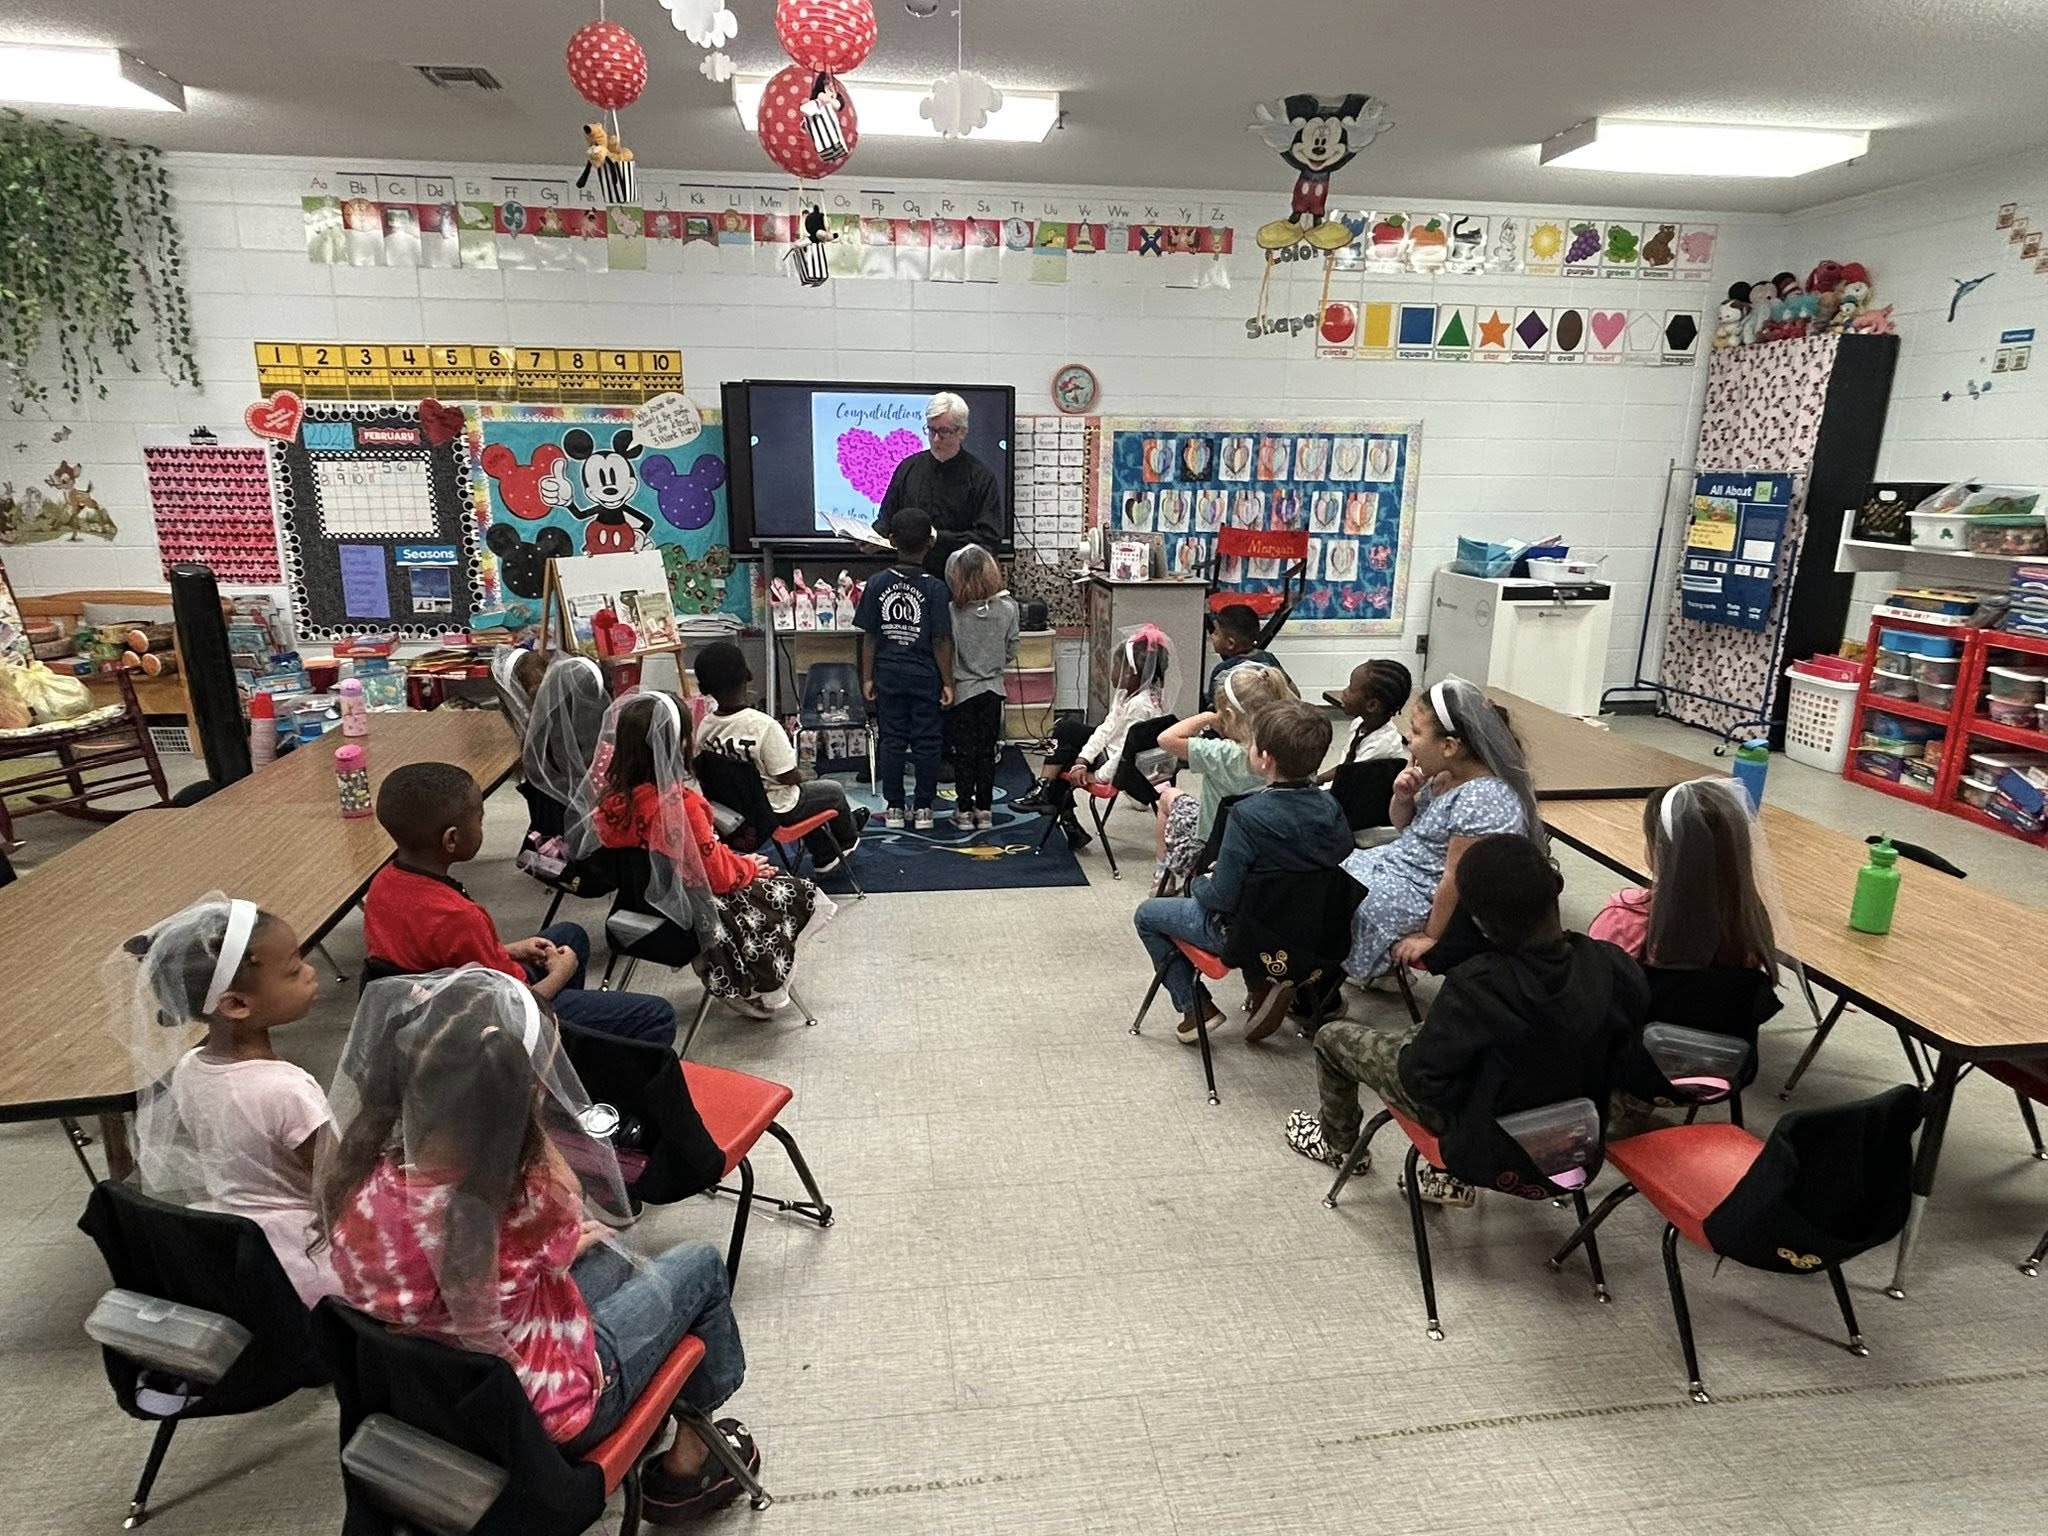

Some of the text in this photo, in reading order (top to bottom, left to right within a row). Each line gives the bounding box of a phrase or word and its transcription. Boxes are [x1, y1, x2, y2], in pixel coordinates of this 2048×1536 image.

[349, 181, 368, 194] Bb
[388, 182, 406, 195] Cc
[426, 183, 444, 197] Dd
[504, 186, 519, 199] Ff
[540, 187, 559, 205] Gg
[579, 189, 595, 202] Hh
[655, 190, 668, 209] Jj
[690, 193, 706, 205] Kk
[729, 194, 741, 207] Ll
[760, 195, 782, 208] Mm
[834, 194, 850, 208] Oo
[871, 199, 885, 216] Pp
[903, 200, 923, 218] Qq
[941, 199, 955, 212] Rr
[977, 200, 991, 213] Ss
[1011, 200, 1025, 213] Tt
[1044, 203, 1058, 216] Uu
[1079, 204, 1092, 217] Vv
[1107, 205, 1130, 218] Ww
[1144, 206, 1159, 218] Xx
[1178, 207, 1192, 223] Yy
[1211, 208, 1226, 221] Zz
[1245, 312, 1322, 340] Shape
[274, 346, 670, 371] 1 2 3 4 5 6 7 8 9 10
[1322, 349, 1348, 357] circle
[1399, 351, 1430, 360] square
[1437, 352, 1469, 361] triangle
[1483, 353, 1500, 361] star
[1511, 353, 1546, 361] diamond
[1557, 354, 1576, 362] oval
[1661, 357, 1694, 366] hexagon
[836, 402, 922, 426] Congratulations
[1040, 421, 1054, 432] you
[1065, 419, 1082, 430] that
[364, 431, 415, 442] FEBRUARY
[1063, 452, 1078, 461] the
[321, 461, 421, 474] 1 2 3 4 5 6 7
[1041, 470, 1051, 479] to
[1066, 470, 1076, 482] of
[1709, 484, 1724, 496] All
[1725, 485, 1753, 497] About
[1247, 539, 1295, 558] Morgan
[402, 549, 455, 560] Seasons
